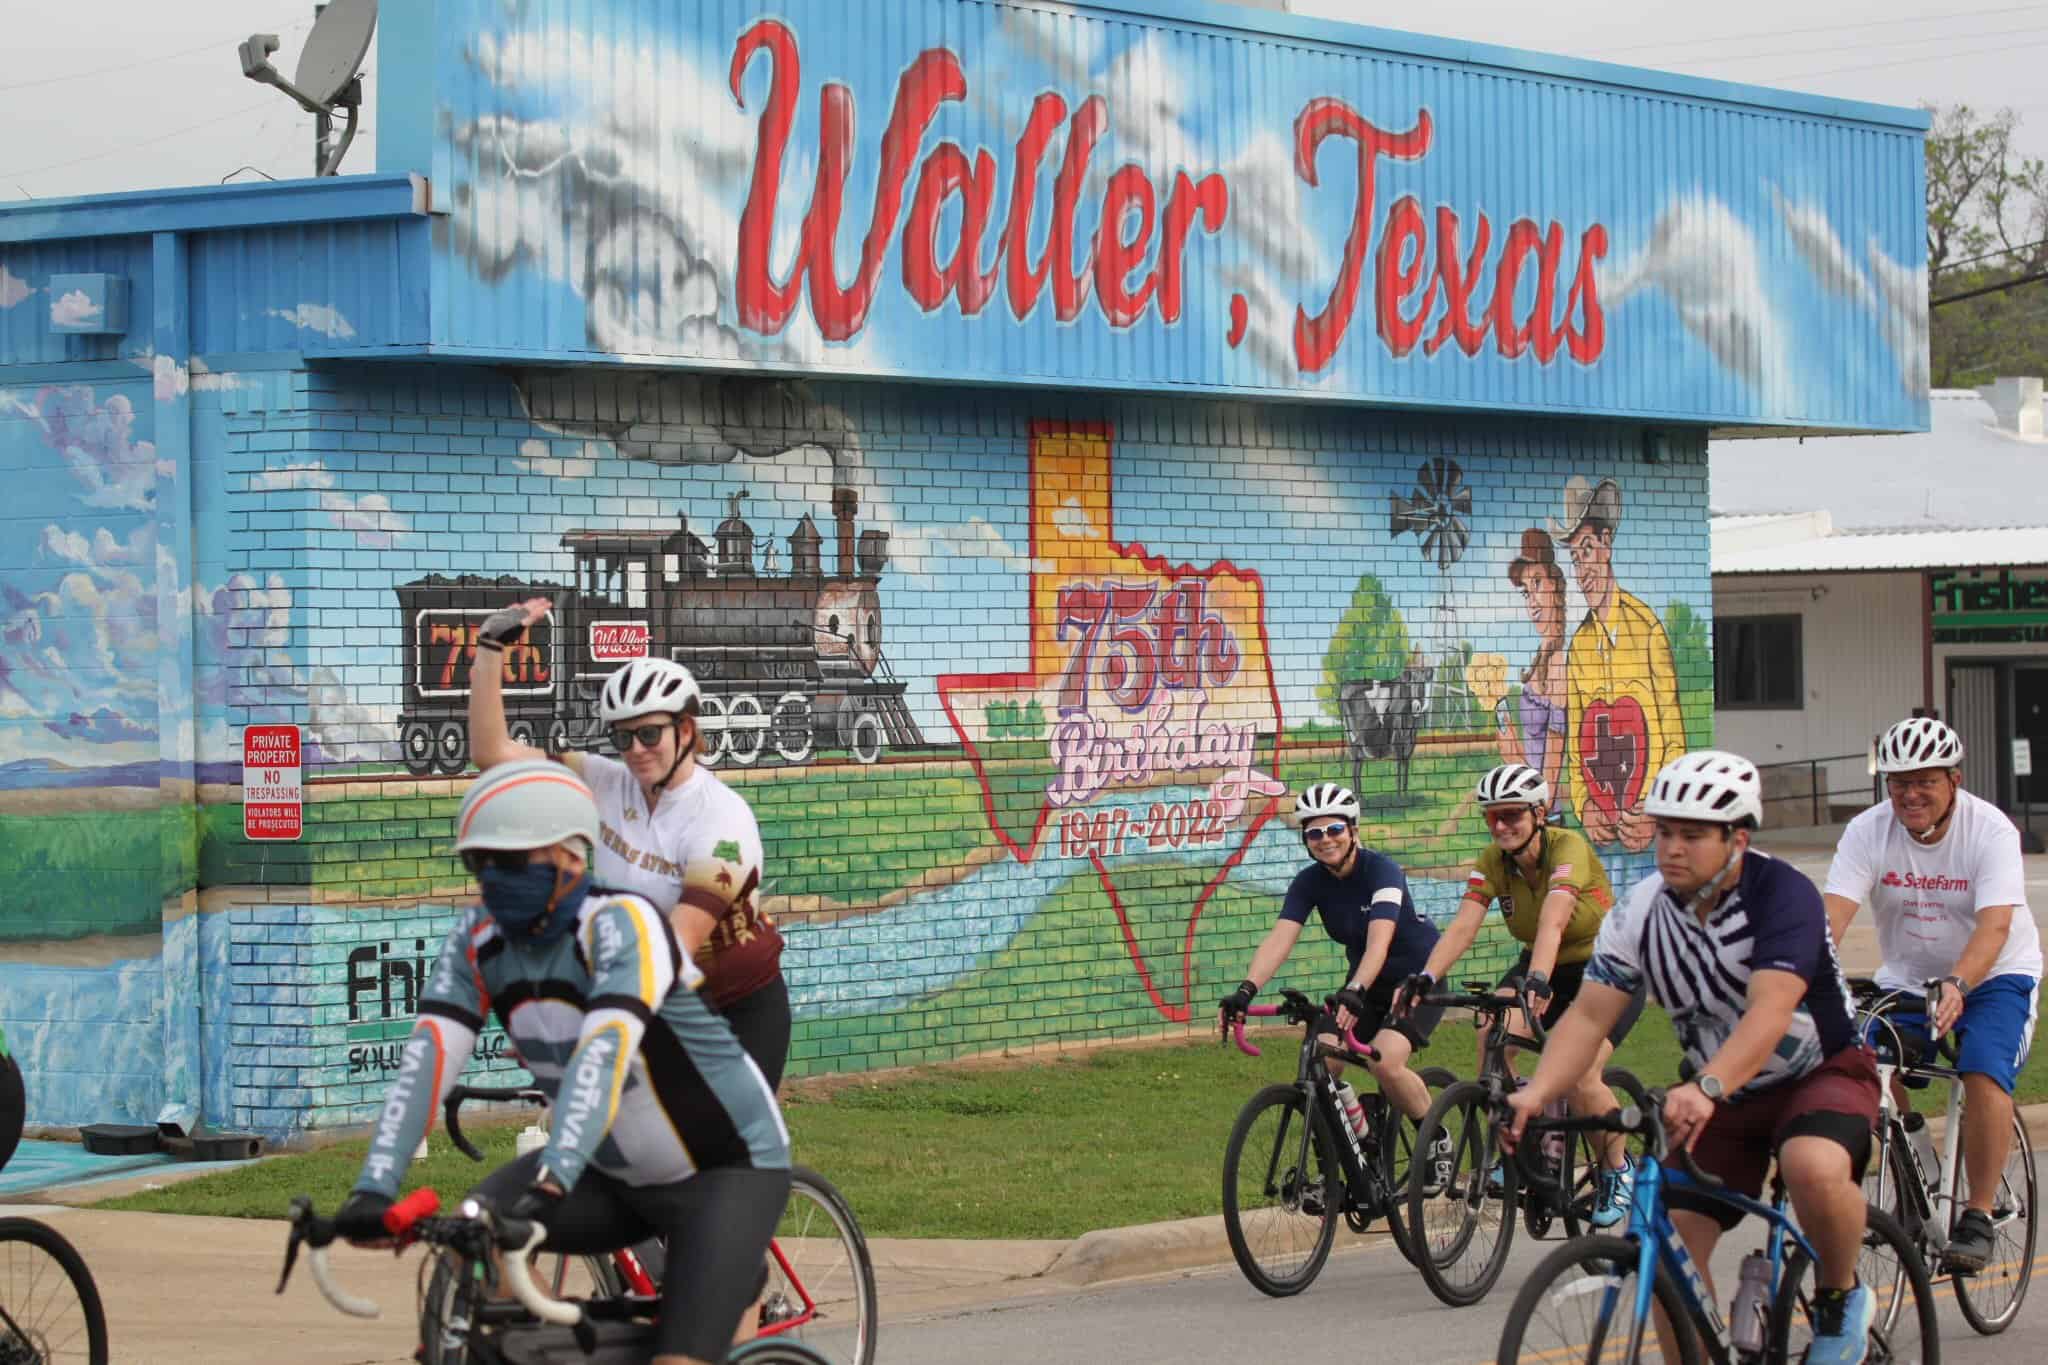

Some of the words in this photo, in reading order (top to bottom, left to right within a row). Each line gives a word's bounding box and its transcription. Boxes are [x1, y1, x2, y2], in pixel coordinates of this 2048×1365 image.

[729, 18, 1248, 349] Waller,
[1293, 96, 1609, 373] Texas
[1056, 577, 1241, 716] 75th
[432, 623, 551, 689] 7th
[252, 735, 292, 749] PRIVATE
[247, 750, 297, 764] PROPERTY
[1046, 687, 1287, 823] Birthday
[264, 769, 281, 785] NO
[246, 786, 300, 800] TRESPASSING
[247, 807, 281, 817] VIOLATORS
[283, 807, 298, 817] WILL
[247, 818, 257, 829] BE
[259, 818, 299, 830] PROSECUTED
[557, 1037, 614, 1150] MOTIVA
